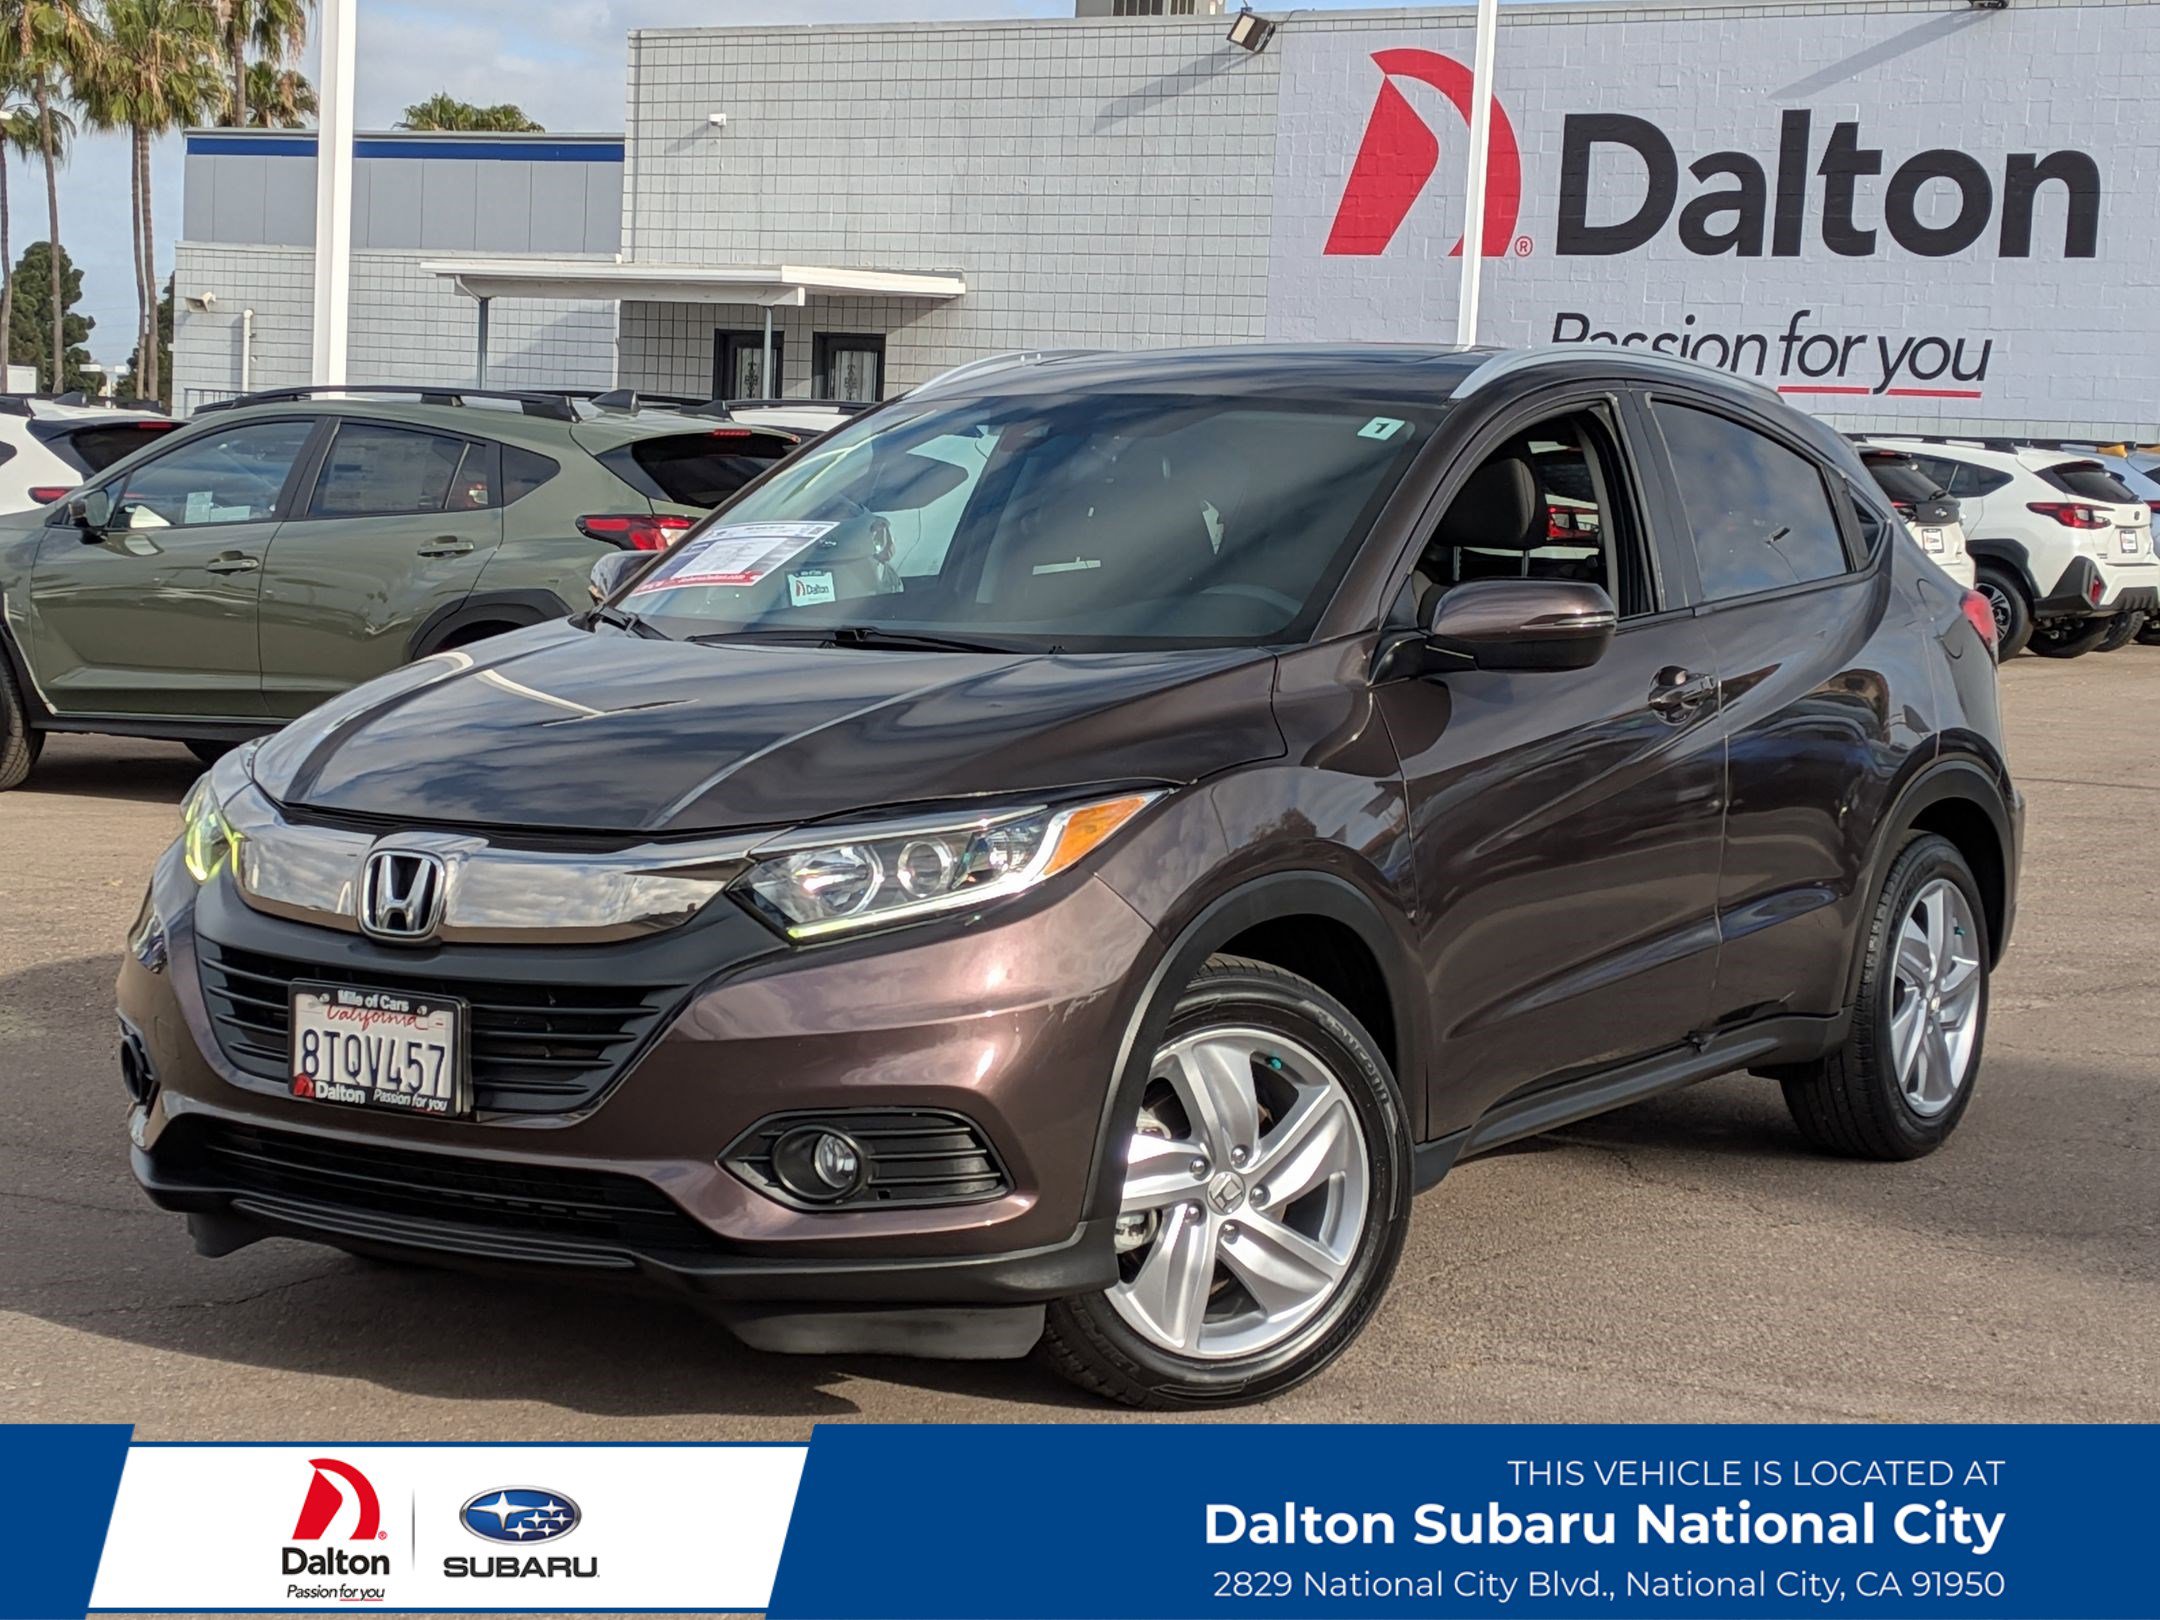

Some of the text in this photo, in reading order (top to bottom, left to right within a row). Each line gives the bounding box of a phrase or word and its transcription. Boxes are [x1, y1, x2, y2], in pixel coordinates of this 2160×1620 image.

[1555, 109, 2101, 258] Dalton
[1778, 309, 1869, 378] for
[1871, 335, 1993, 396] you
[806, 584, 830, 595] Dalton
[337, 989, 410, 1012] Mile of Cars
[326, 1004, 428, 1032] California
[301, 1028, 446, 1098] 8TQV457
[315, 1080, 448, 1112] Dalton Passion for you
